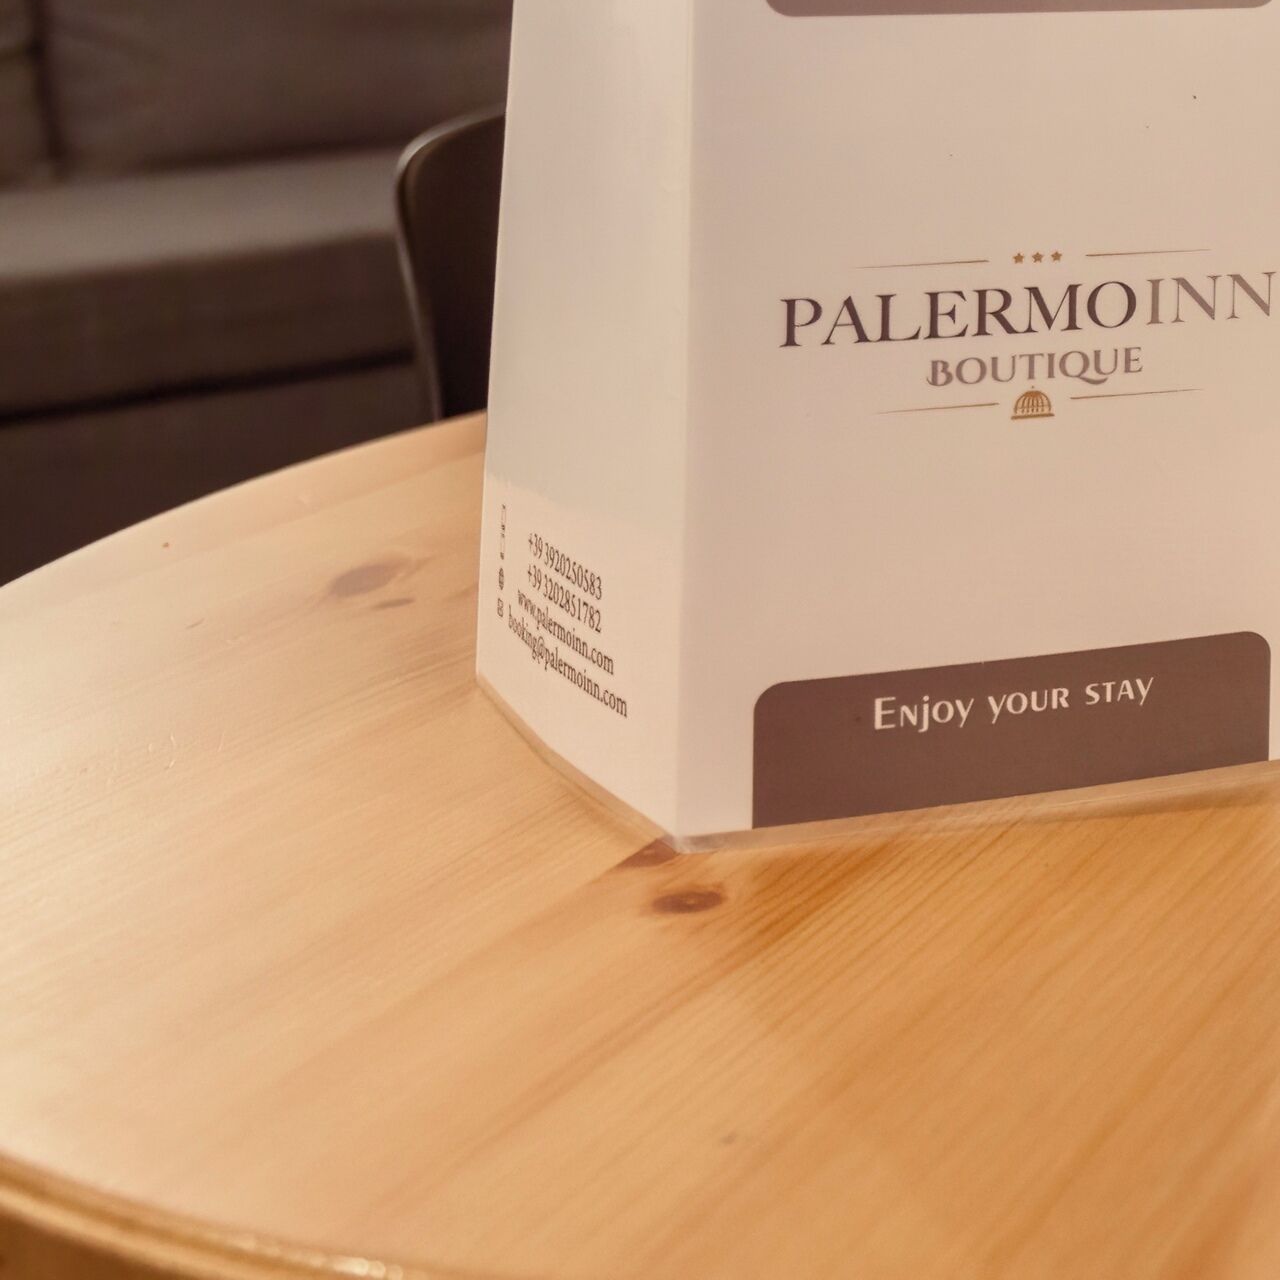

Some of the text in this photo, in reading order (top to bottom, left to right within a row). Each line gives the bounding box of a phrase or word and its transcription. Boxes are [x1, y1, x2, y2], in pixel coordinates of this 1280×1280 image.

[926, 346, 1144, 387] BOUTIQUE
[527, 532, 543, 559] +39
[527, 563, 542, 591] +39
[517, 588, 614, 676] www.palermoinn.com
[508, 604, 628, 719] booking@palermoinn.com
